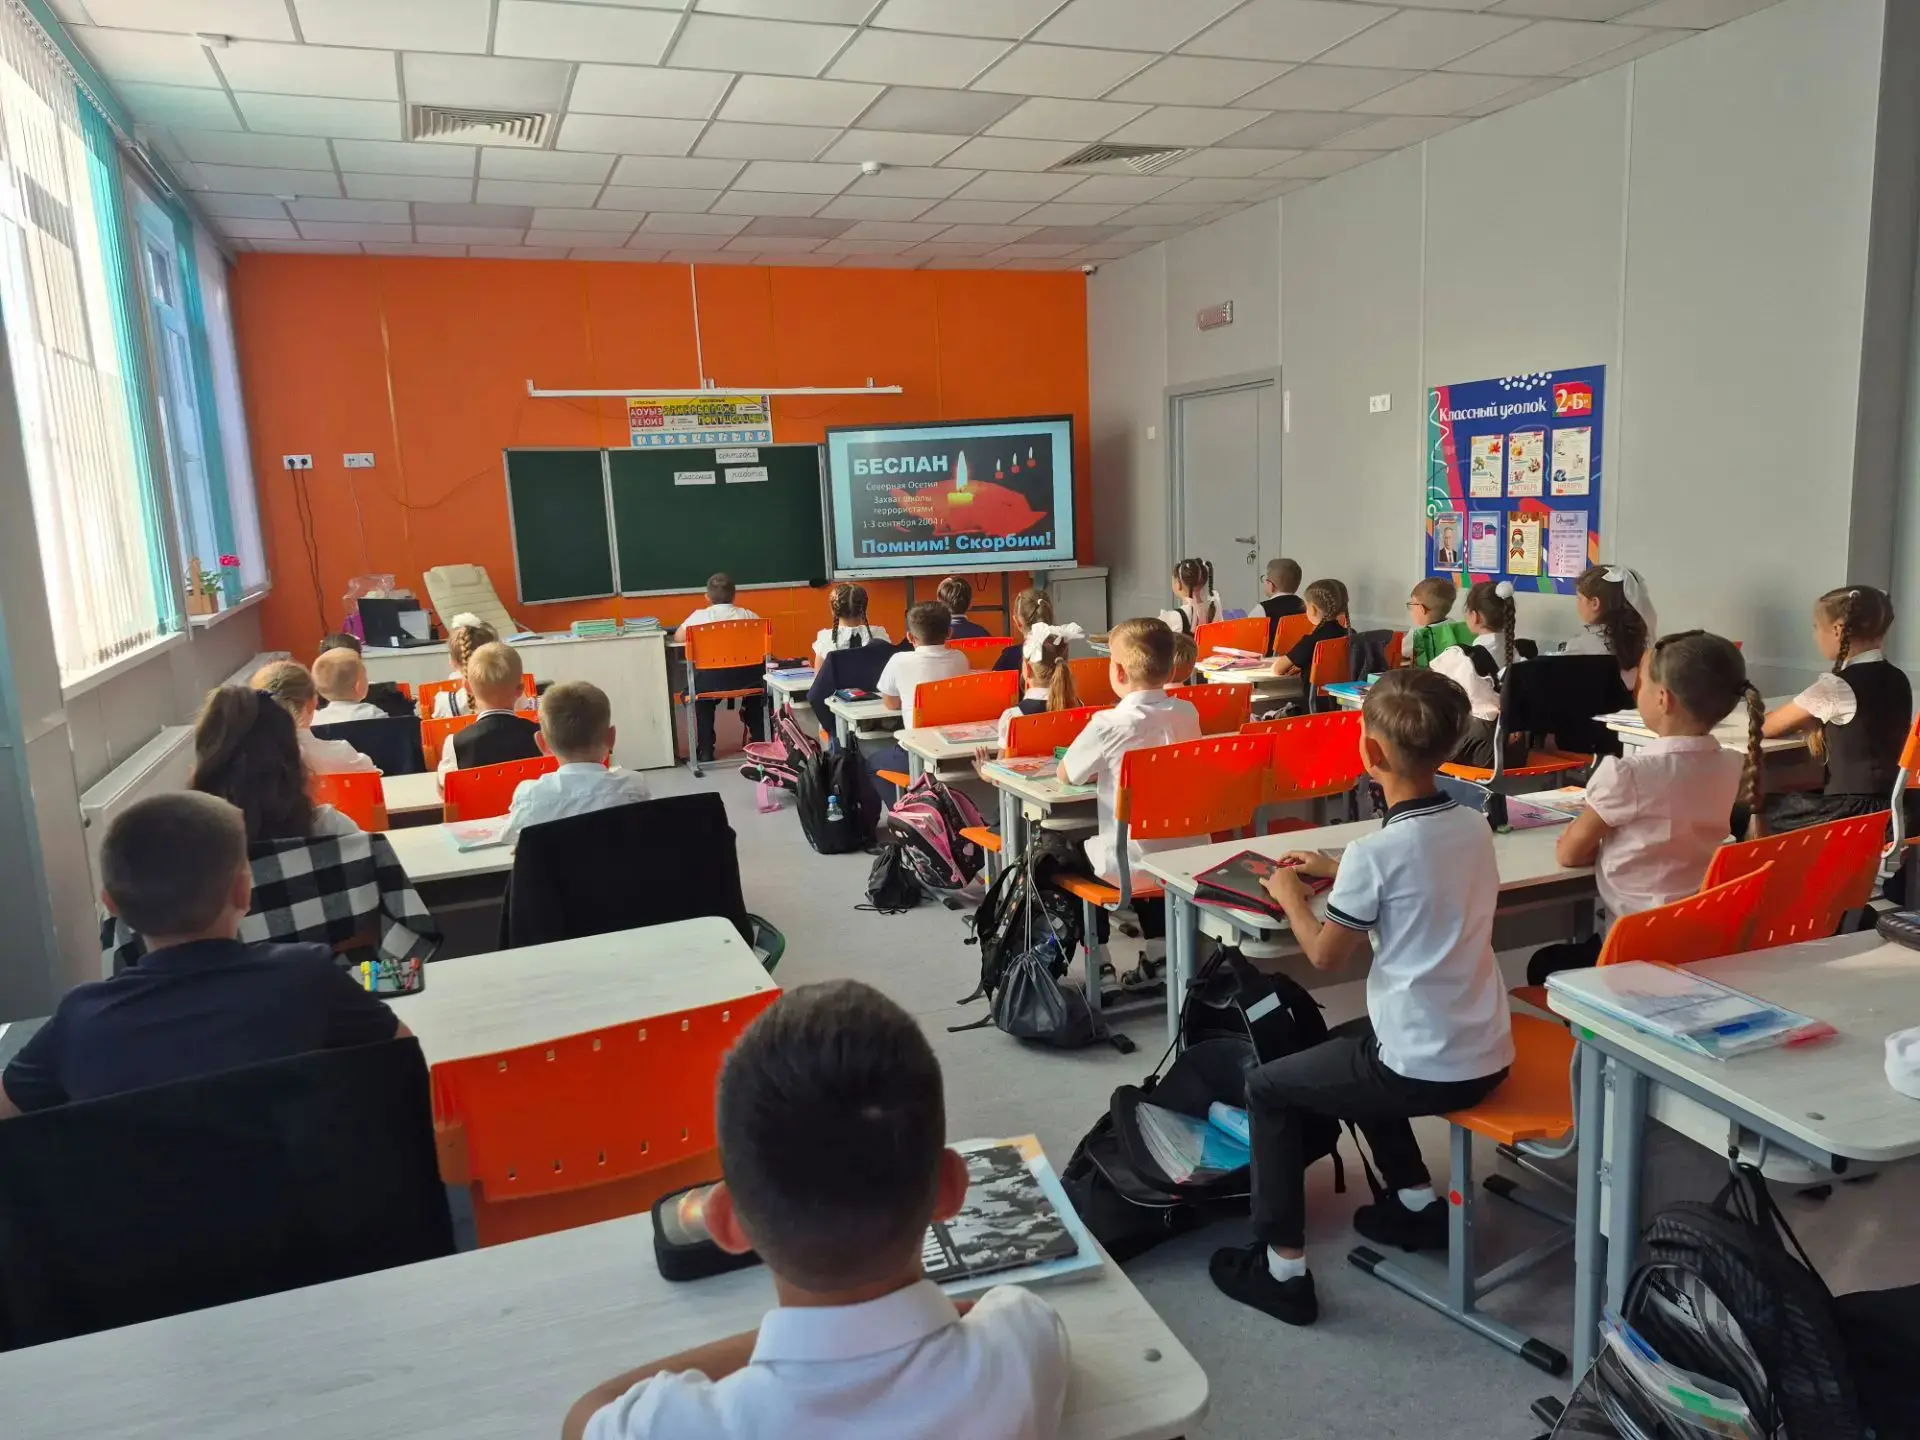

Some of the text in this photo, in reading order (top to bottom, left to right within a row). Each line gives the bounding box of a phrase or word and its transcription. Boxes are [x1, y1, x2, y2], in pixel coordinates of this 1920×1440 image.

[1439, 397, 1548, 422] Классный уголок
[853, 455, 949, 475] БЕСЛАН
[865, 480, 938, 491] Северная Осетия
[873, 495, 932, 504] Захват школы
[873, 505, 934, 515] террористами
[863, 520, 876, 528] 1-3
[877, 518, 916, 528] сентября
[918, 517, 939, 526] 2004
[861, 531, 1052, 554] Помним! Скорбим!
